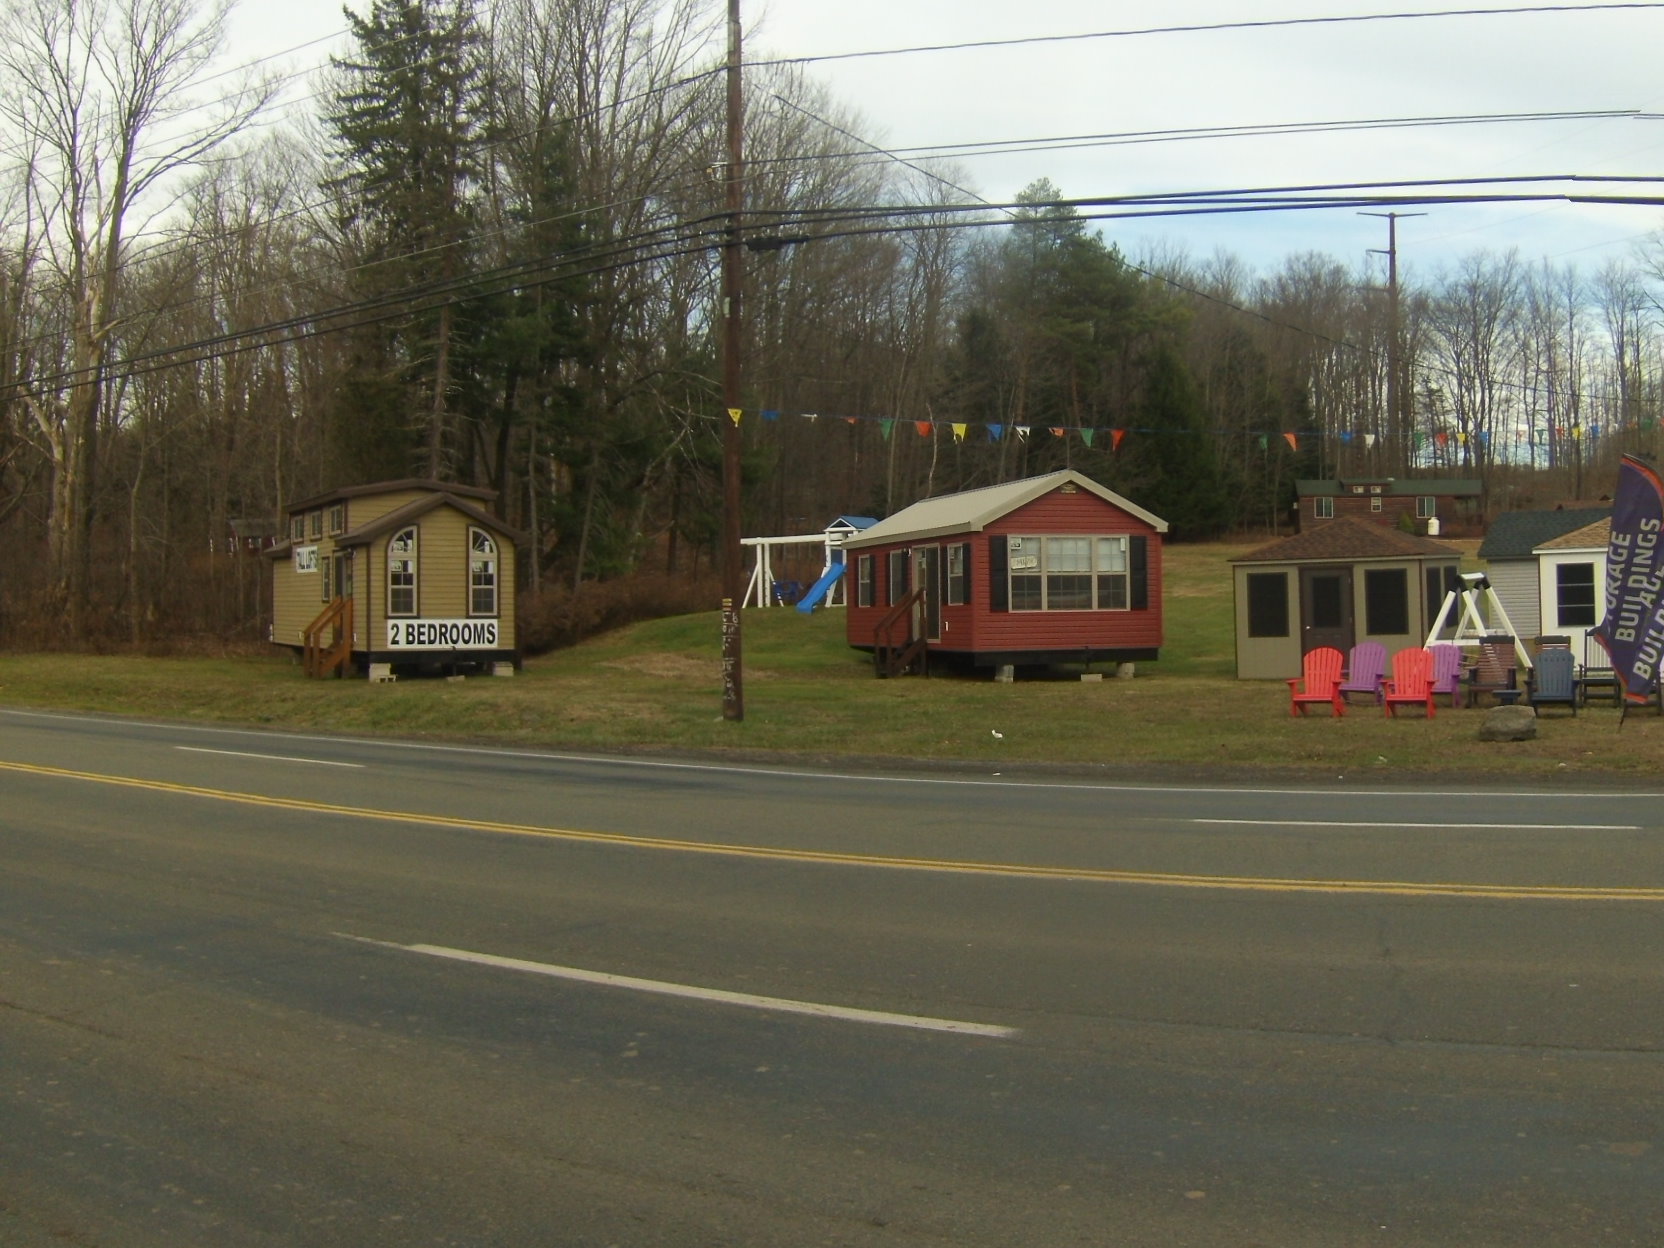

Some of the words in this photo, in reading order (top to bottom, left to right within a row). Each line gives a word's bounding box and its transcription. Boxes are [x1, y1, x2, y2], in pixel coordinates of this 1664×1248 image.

[1616, 518, 1661, 643] BUILDINGS
[390, 623, 400, 645] 2
[405, 623, 496, 645] BEDROOMS
